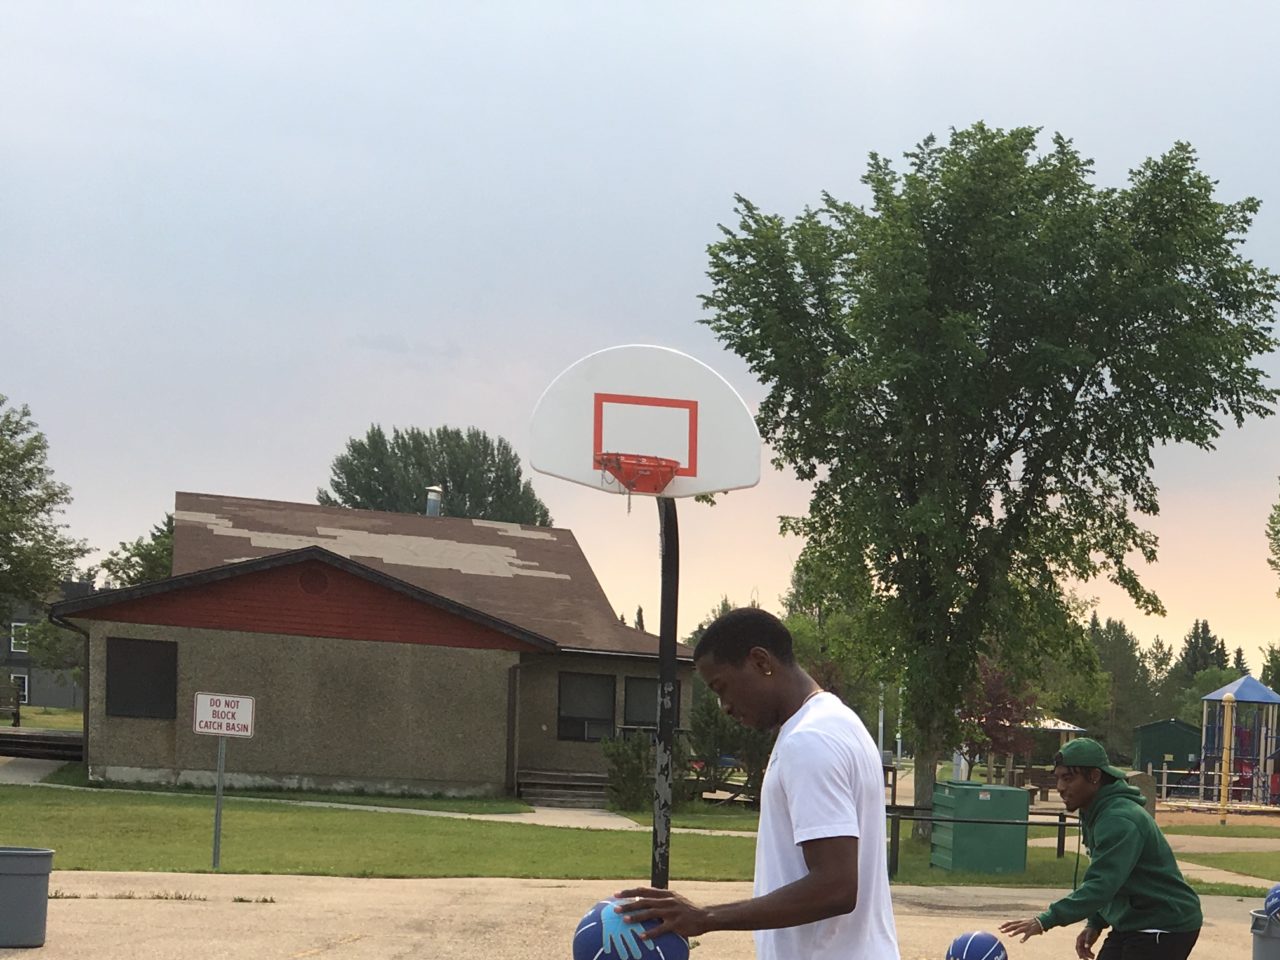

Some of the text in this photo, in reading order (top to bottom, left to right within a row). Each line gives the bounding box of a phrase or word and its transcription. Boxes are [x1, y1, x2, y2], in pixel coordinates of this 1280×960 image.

[209, 698, 240, 709] DO NOT
[212, 709, 236, 720] BLOCK
[198, 720, 249, 733] CATCH BASIN
